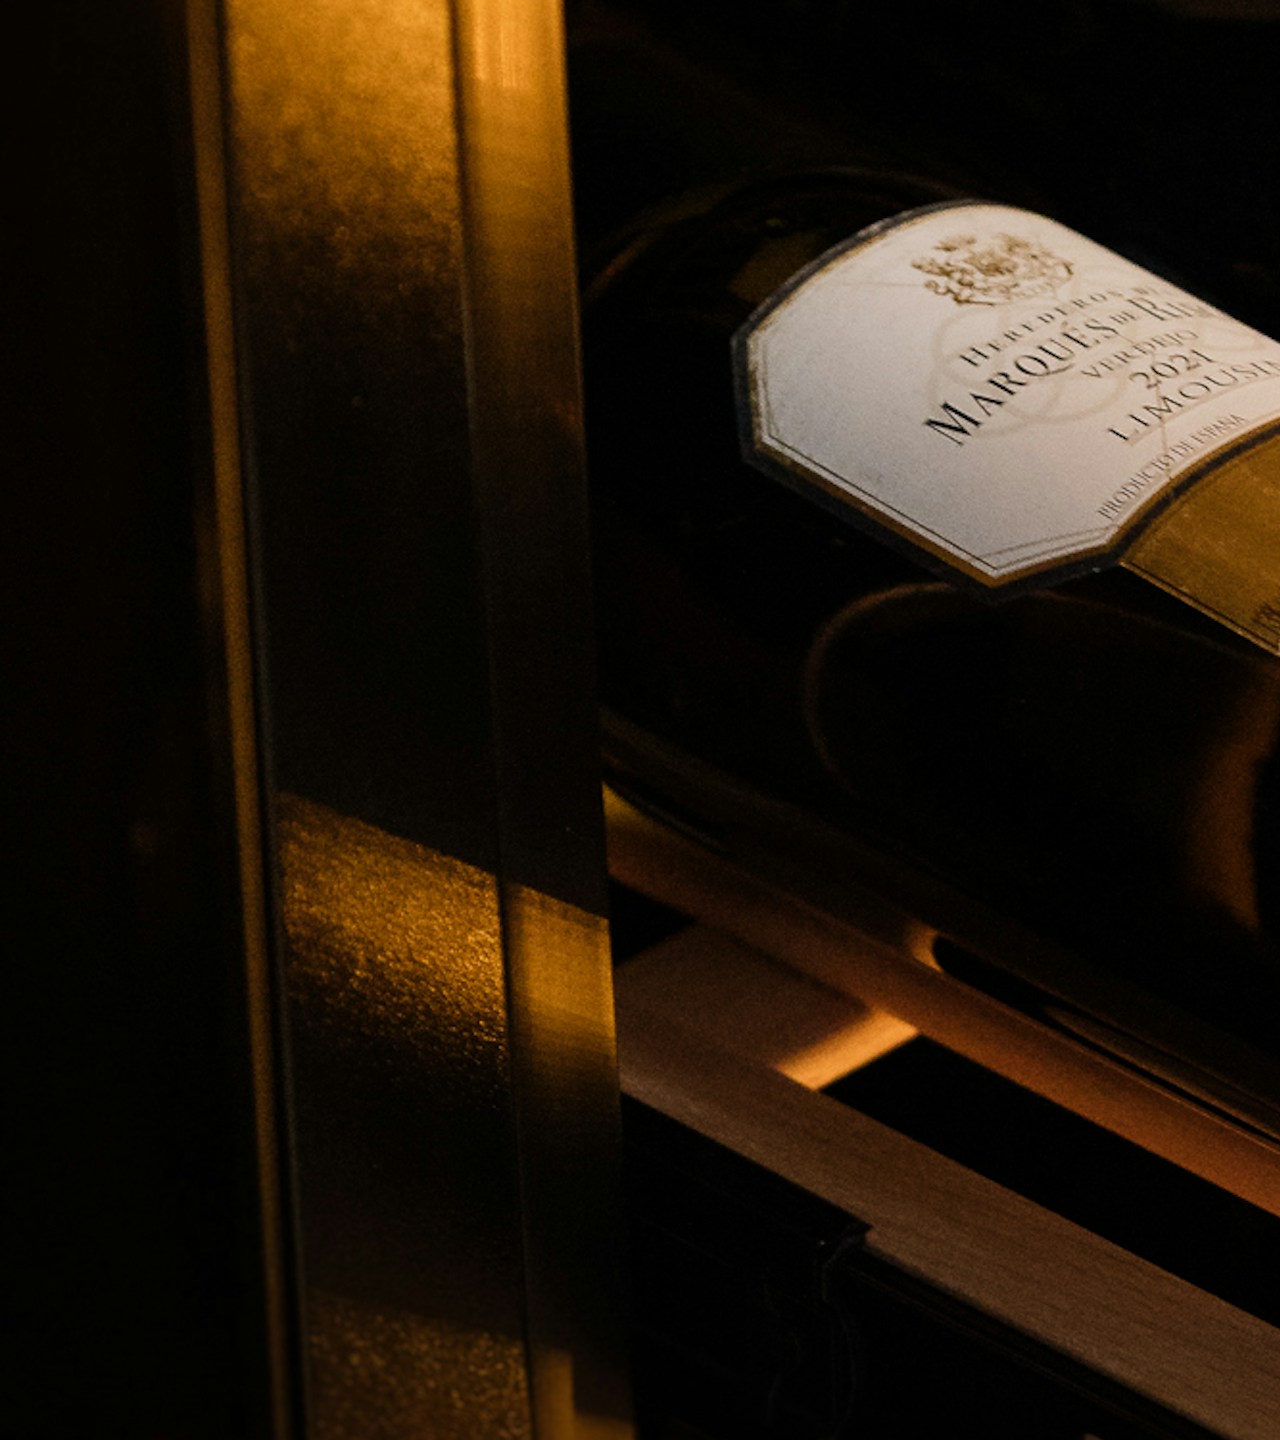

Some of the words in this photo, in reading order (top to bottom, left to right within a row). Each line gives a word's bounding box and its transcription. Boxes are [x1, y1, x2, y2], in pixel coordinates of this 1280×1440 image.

[957, 289, 1126, 369] HEREDEROS
[1080, 327, 1200, 380] VERDEJO
[1127, 347, 1219, 391] 2021
[923, 316, 1121, 448] MARQUÉS
[1107, 308, 1140, 327] DE
[1095, 448, 1177, 522] PRODUCTO
[1169, 435, 1196, 461] DE
[1189, 412, 1249, 448] ESPAÑA
